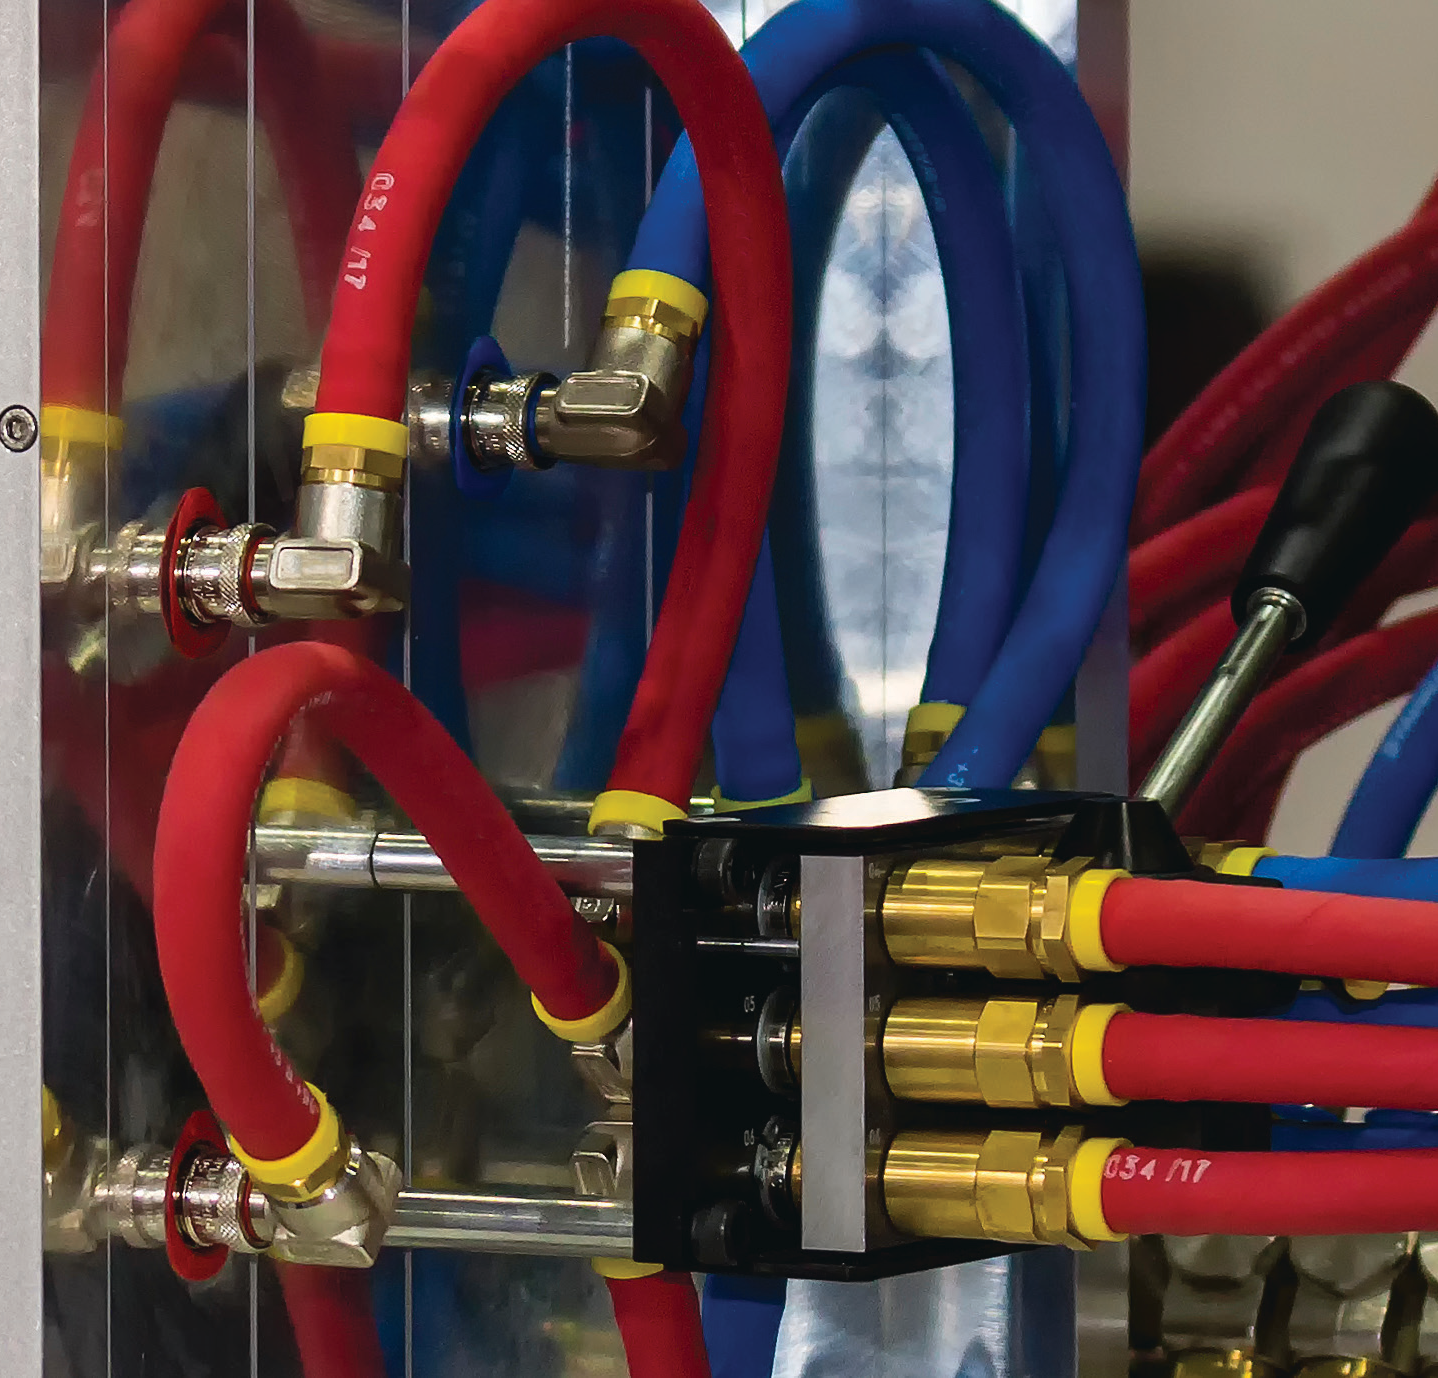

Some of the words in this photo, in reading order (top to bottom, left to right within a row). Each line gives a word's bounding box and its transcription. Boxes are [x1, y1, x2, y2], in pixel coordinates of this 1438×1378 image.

[357, 172, 395, 231] 034
[742, 994, 756, 1014] 05
[742, 1127, 755, 1147] 06
